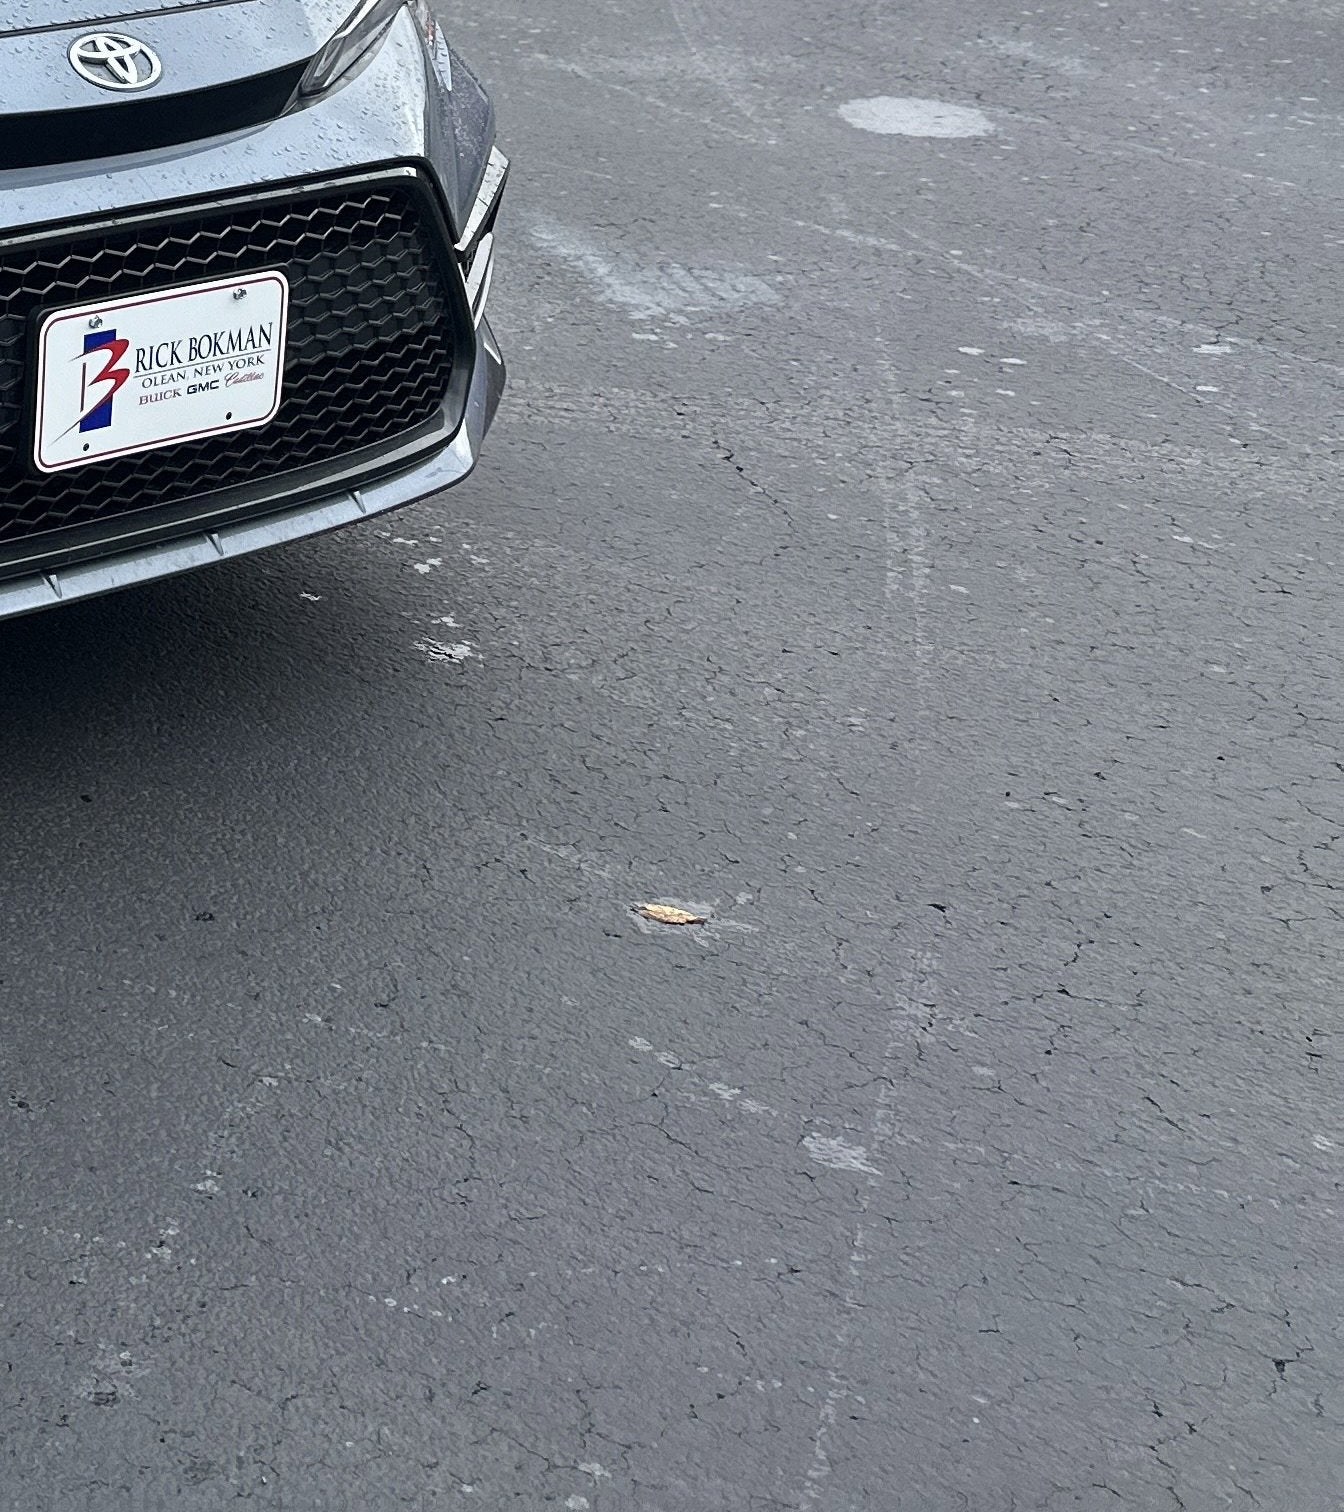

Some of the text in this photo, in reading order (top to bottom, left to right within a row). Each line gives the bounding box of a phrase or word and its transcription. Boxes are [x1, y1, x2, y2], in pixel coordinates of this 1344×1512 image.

[135, 322, 273, 373] RICK BOKMAN
[193, 362, 224, 378] NEW
[227, 354, 265, 371] YORK
[138, 388, 183, 406] BUICK
[186, 379, 220, 395] GMC
